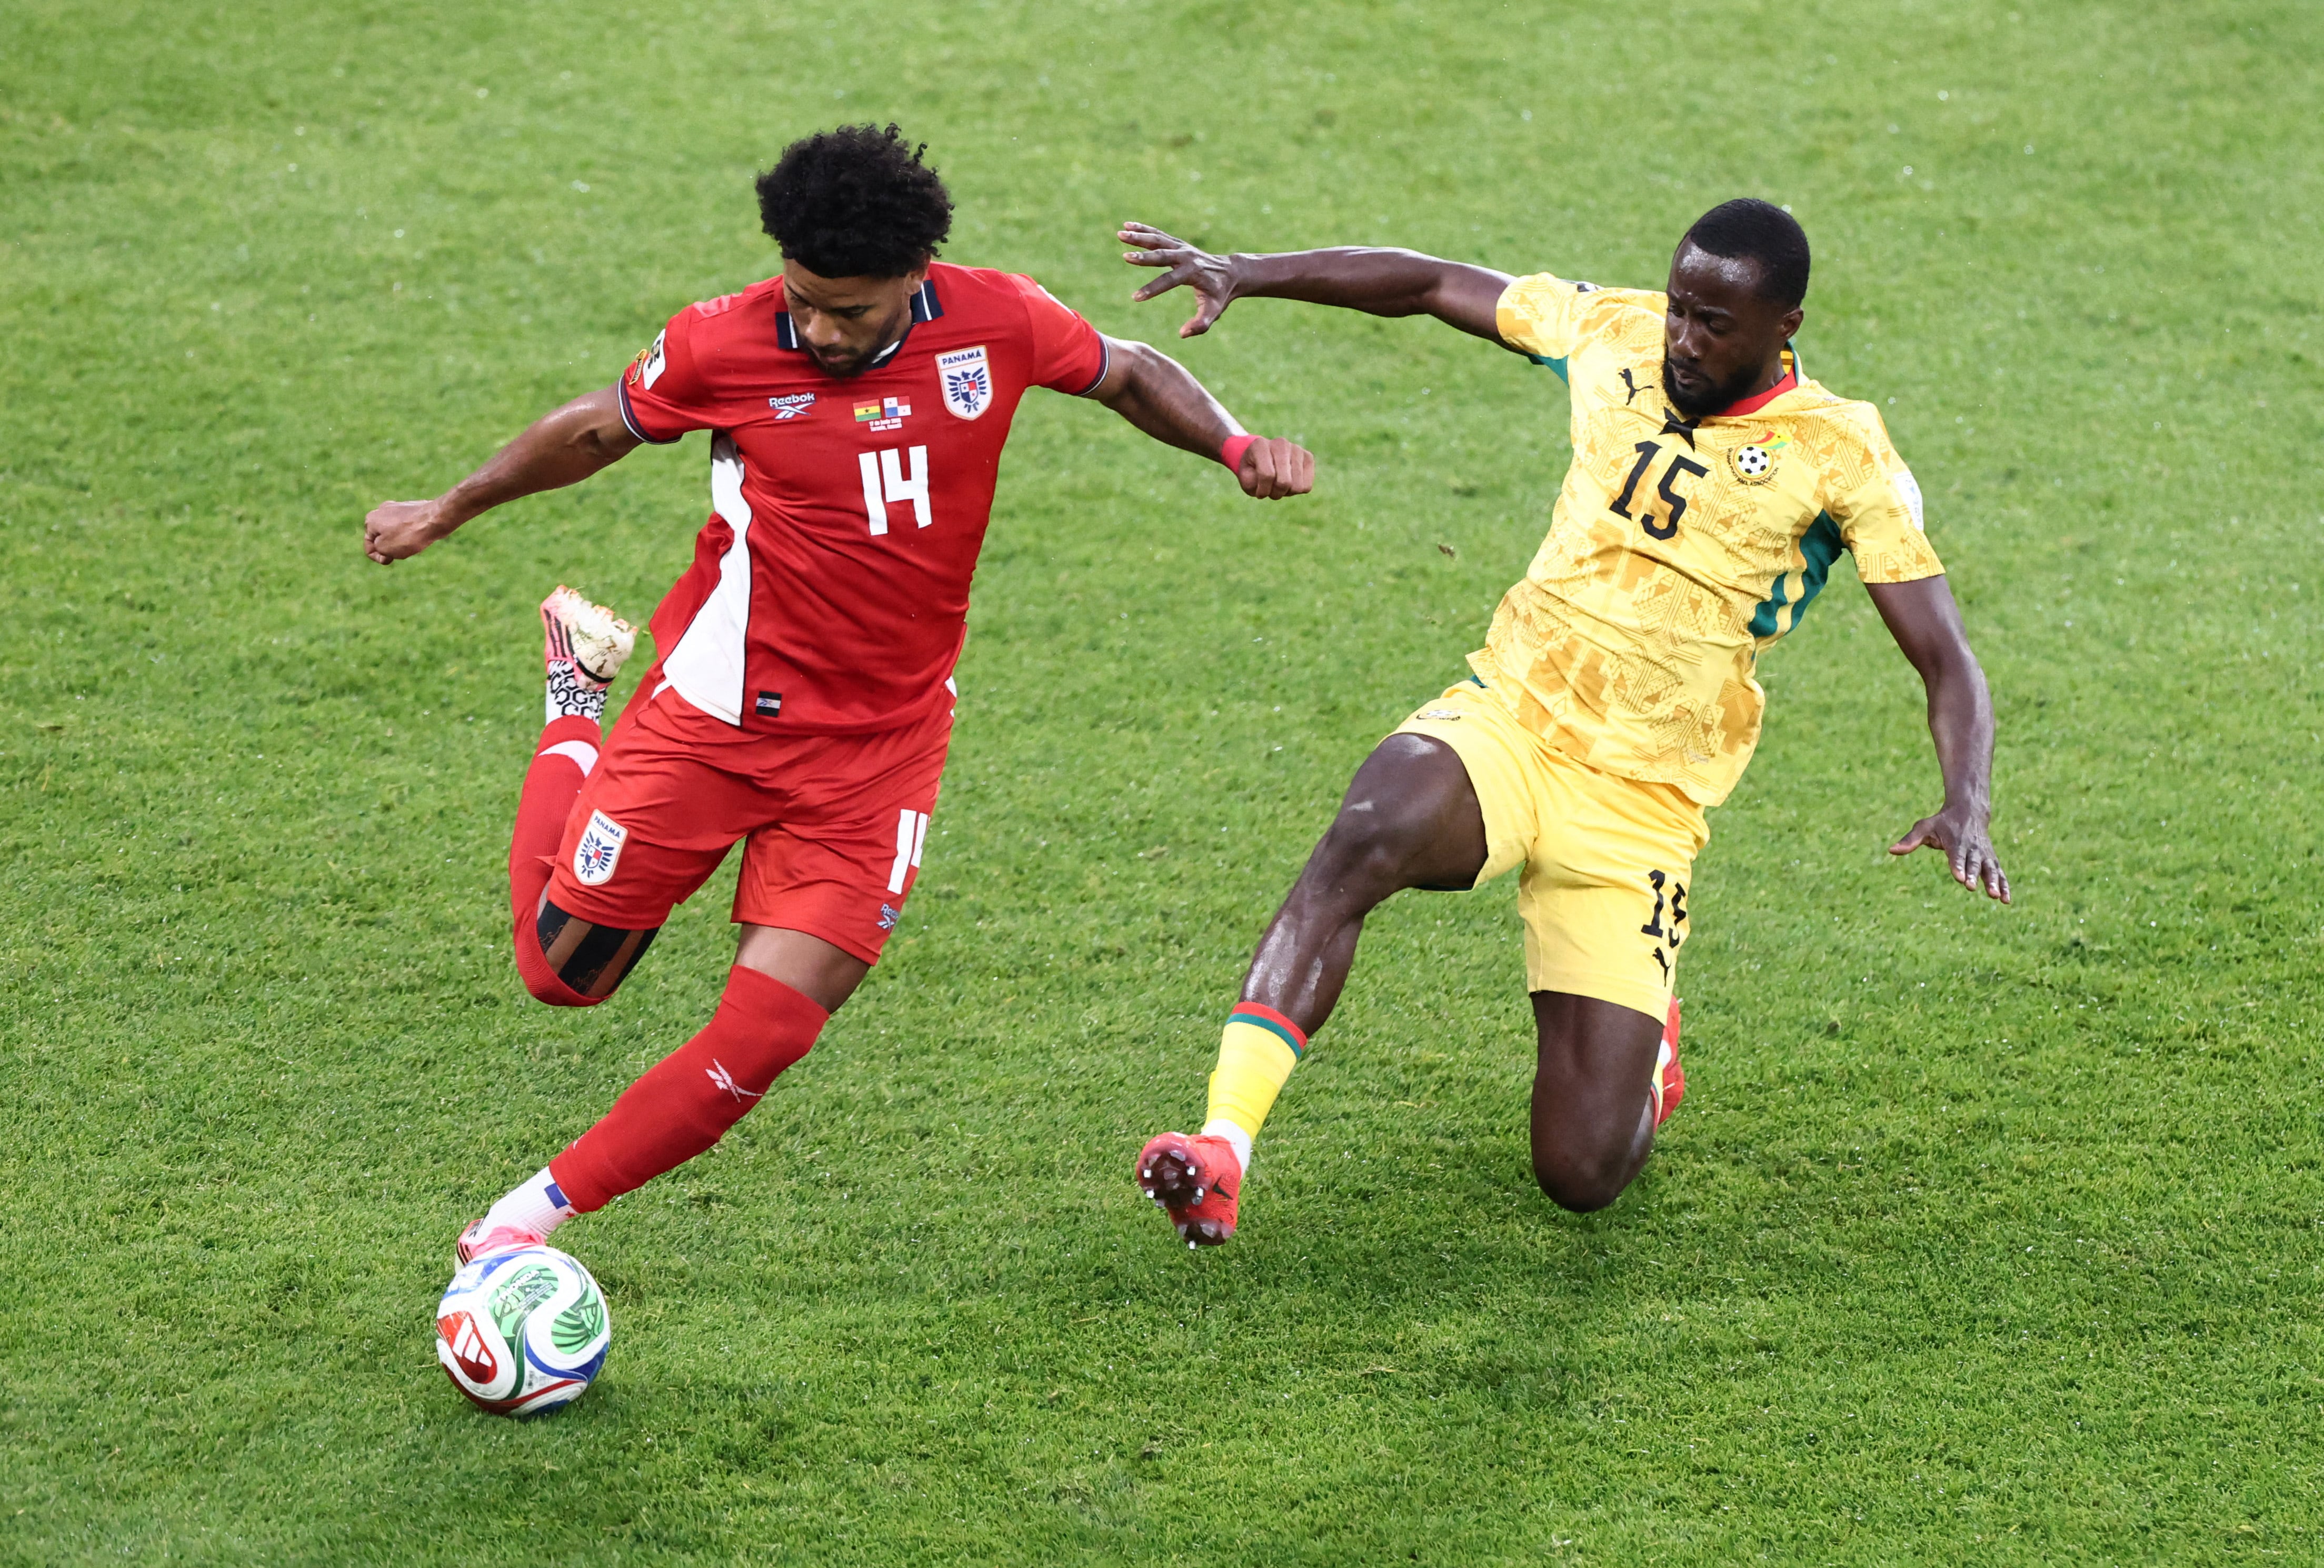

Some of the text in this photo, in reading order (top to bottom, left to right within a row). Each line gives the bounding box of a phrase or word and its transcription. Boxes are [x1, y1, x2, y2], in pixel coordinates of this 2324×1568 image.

[769, 392, 815, 407] Reebok
[858, 445, 932, 536] 14
[1609, 440, 1711, 541] 15
[1641, 869, 1687, 948] 15
